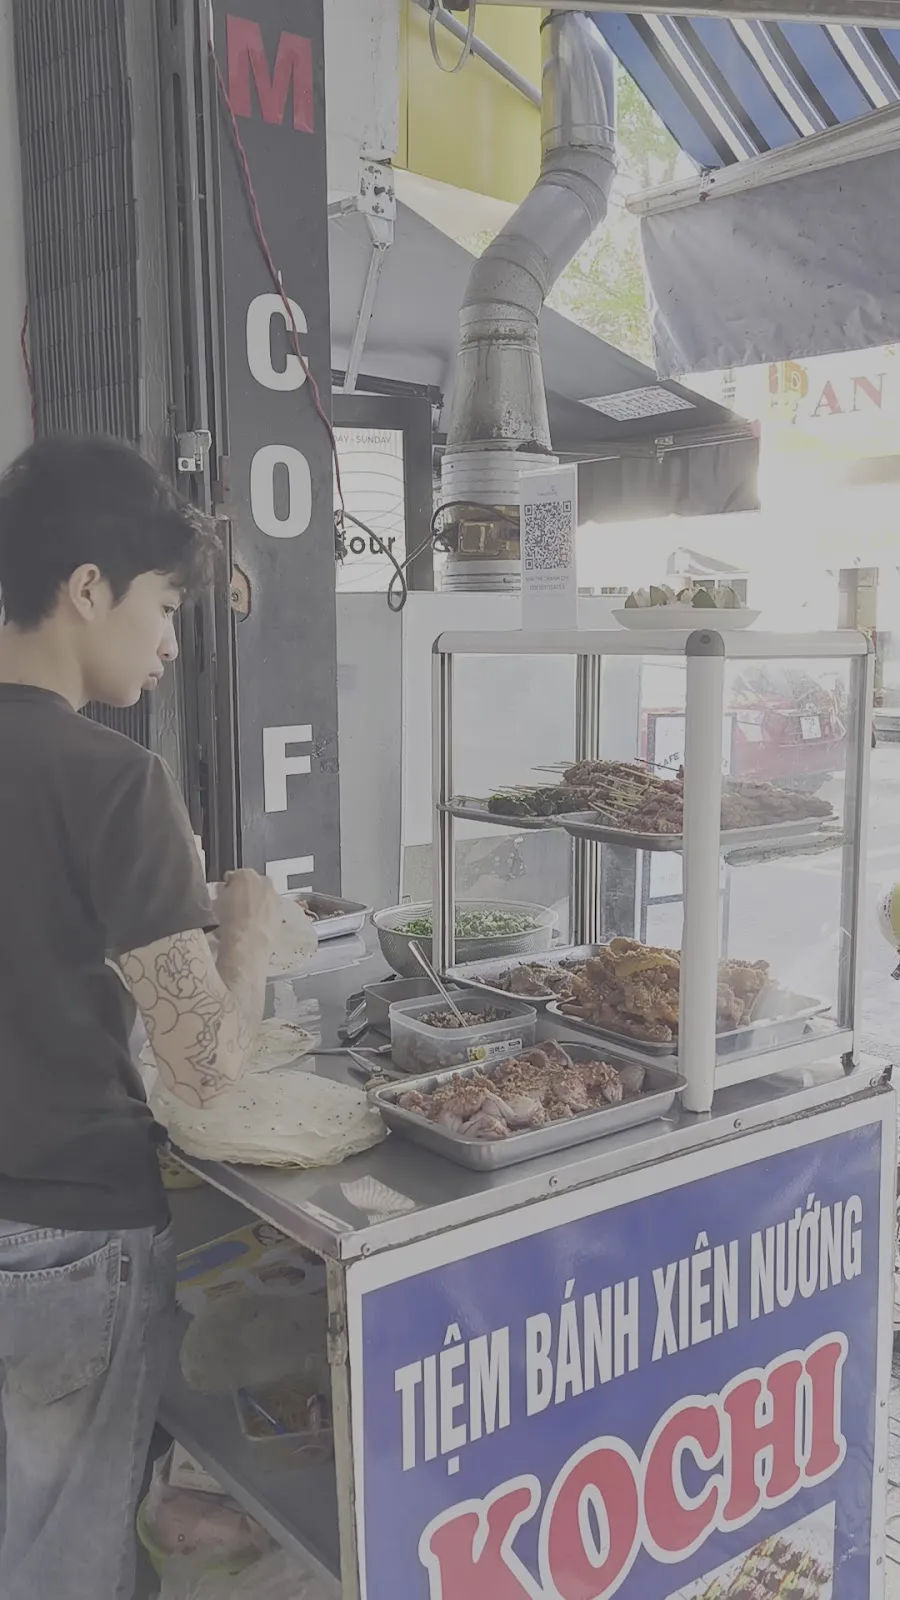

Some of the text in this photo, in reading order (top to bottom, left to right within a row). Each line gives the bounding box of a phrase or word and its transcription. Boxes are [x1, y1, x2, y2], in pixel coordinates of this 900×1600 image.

[226, 14, 315, 134] M
[355, 434, 392, 444] SUNDAY
[394, 1192, 863, 1476] TIỆM BÁNH XIÊN NƯỚNG
[418, 1330, 848, 1600] KOCHI
